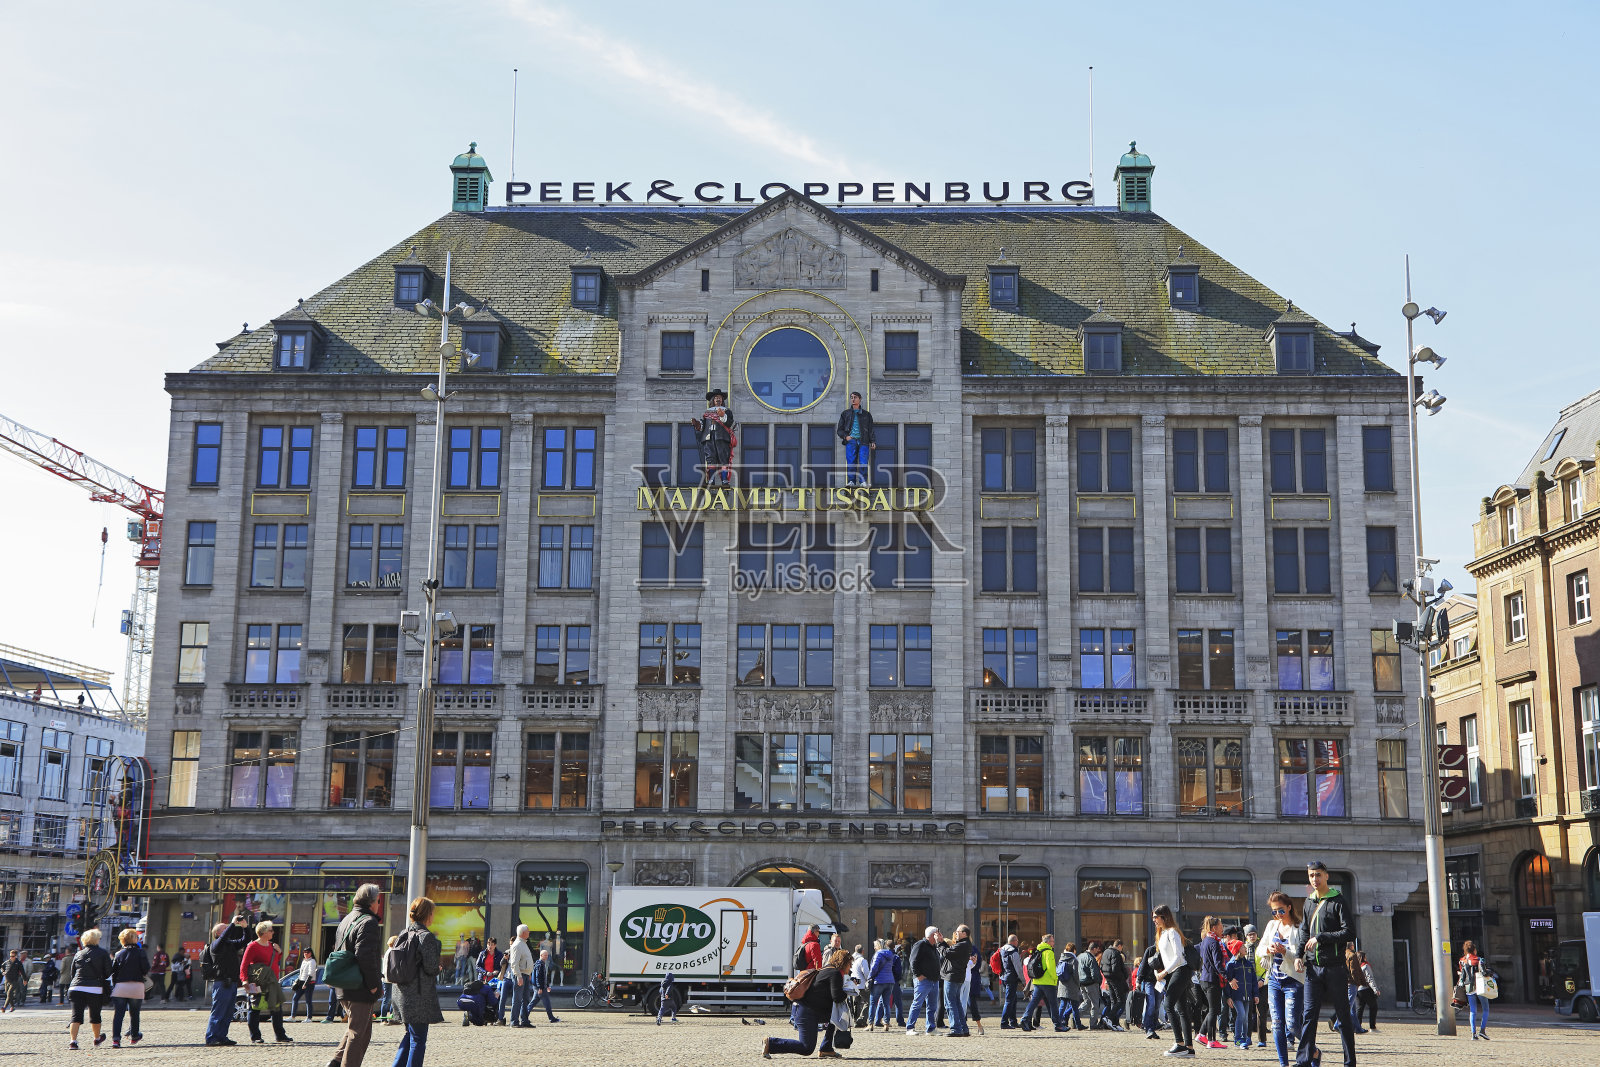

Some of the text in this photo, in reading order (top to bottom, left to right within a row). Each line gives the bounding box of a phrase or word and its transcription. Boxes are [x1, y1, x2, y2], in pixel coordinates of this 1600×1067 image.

[637, 486, 935, 511] MADAME TUSSAUD
[127, 878, 280, 890] MADAME TUSSAUD
[625, 916, 712, 944] Sligro
[655, 936, 731, 970] BEZORGSERVICE
